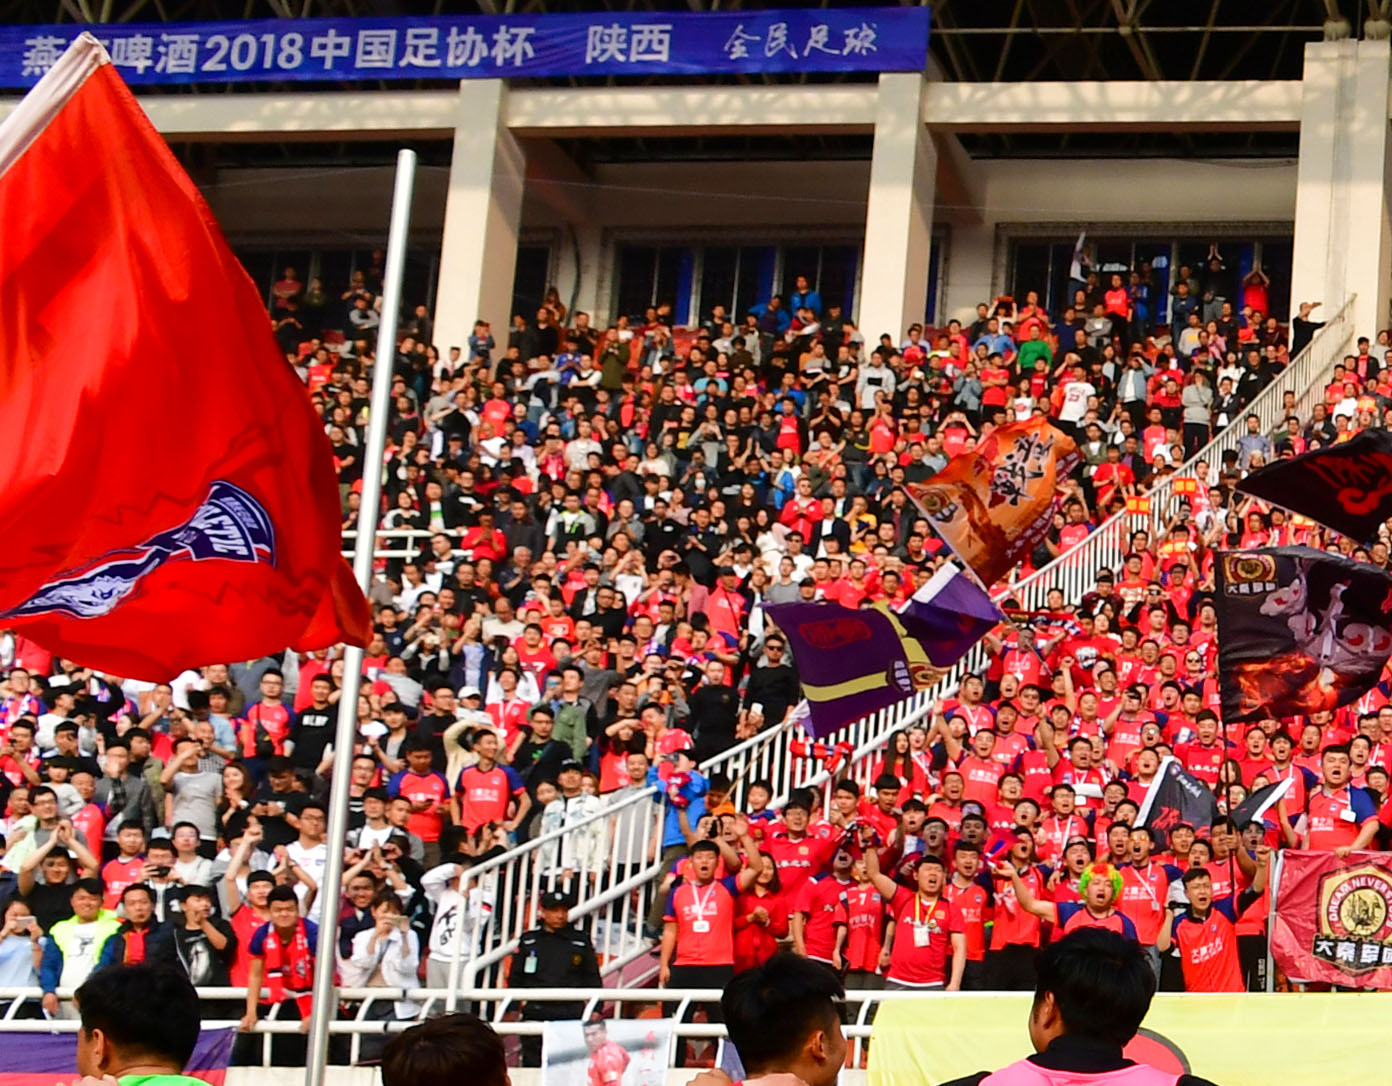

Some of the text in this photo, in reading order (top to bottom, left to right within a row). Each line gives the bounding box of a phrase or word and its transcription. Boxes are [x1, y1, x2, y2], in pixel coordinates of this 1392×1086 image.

[21, 22, 879, 77] 燕啤酒2018中国足协杯 陕西 全民足球
